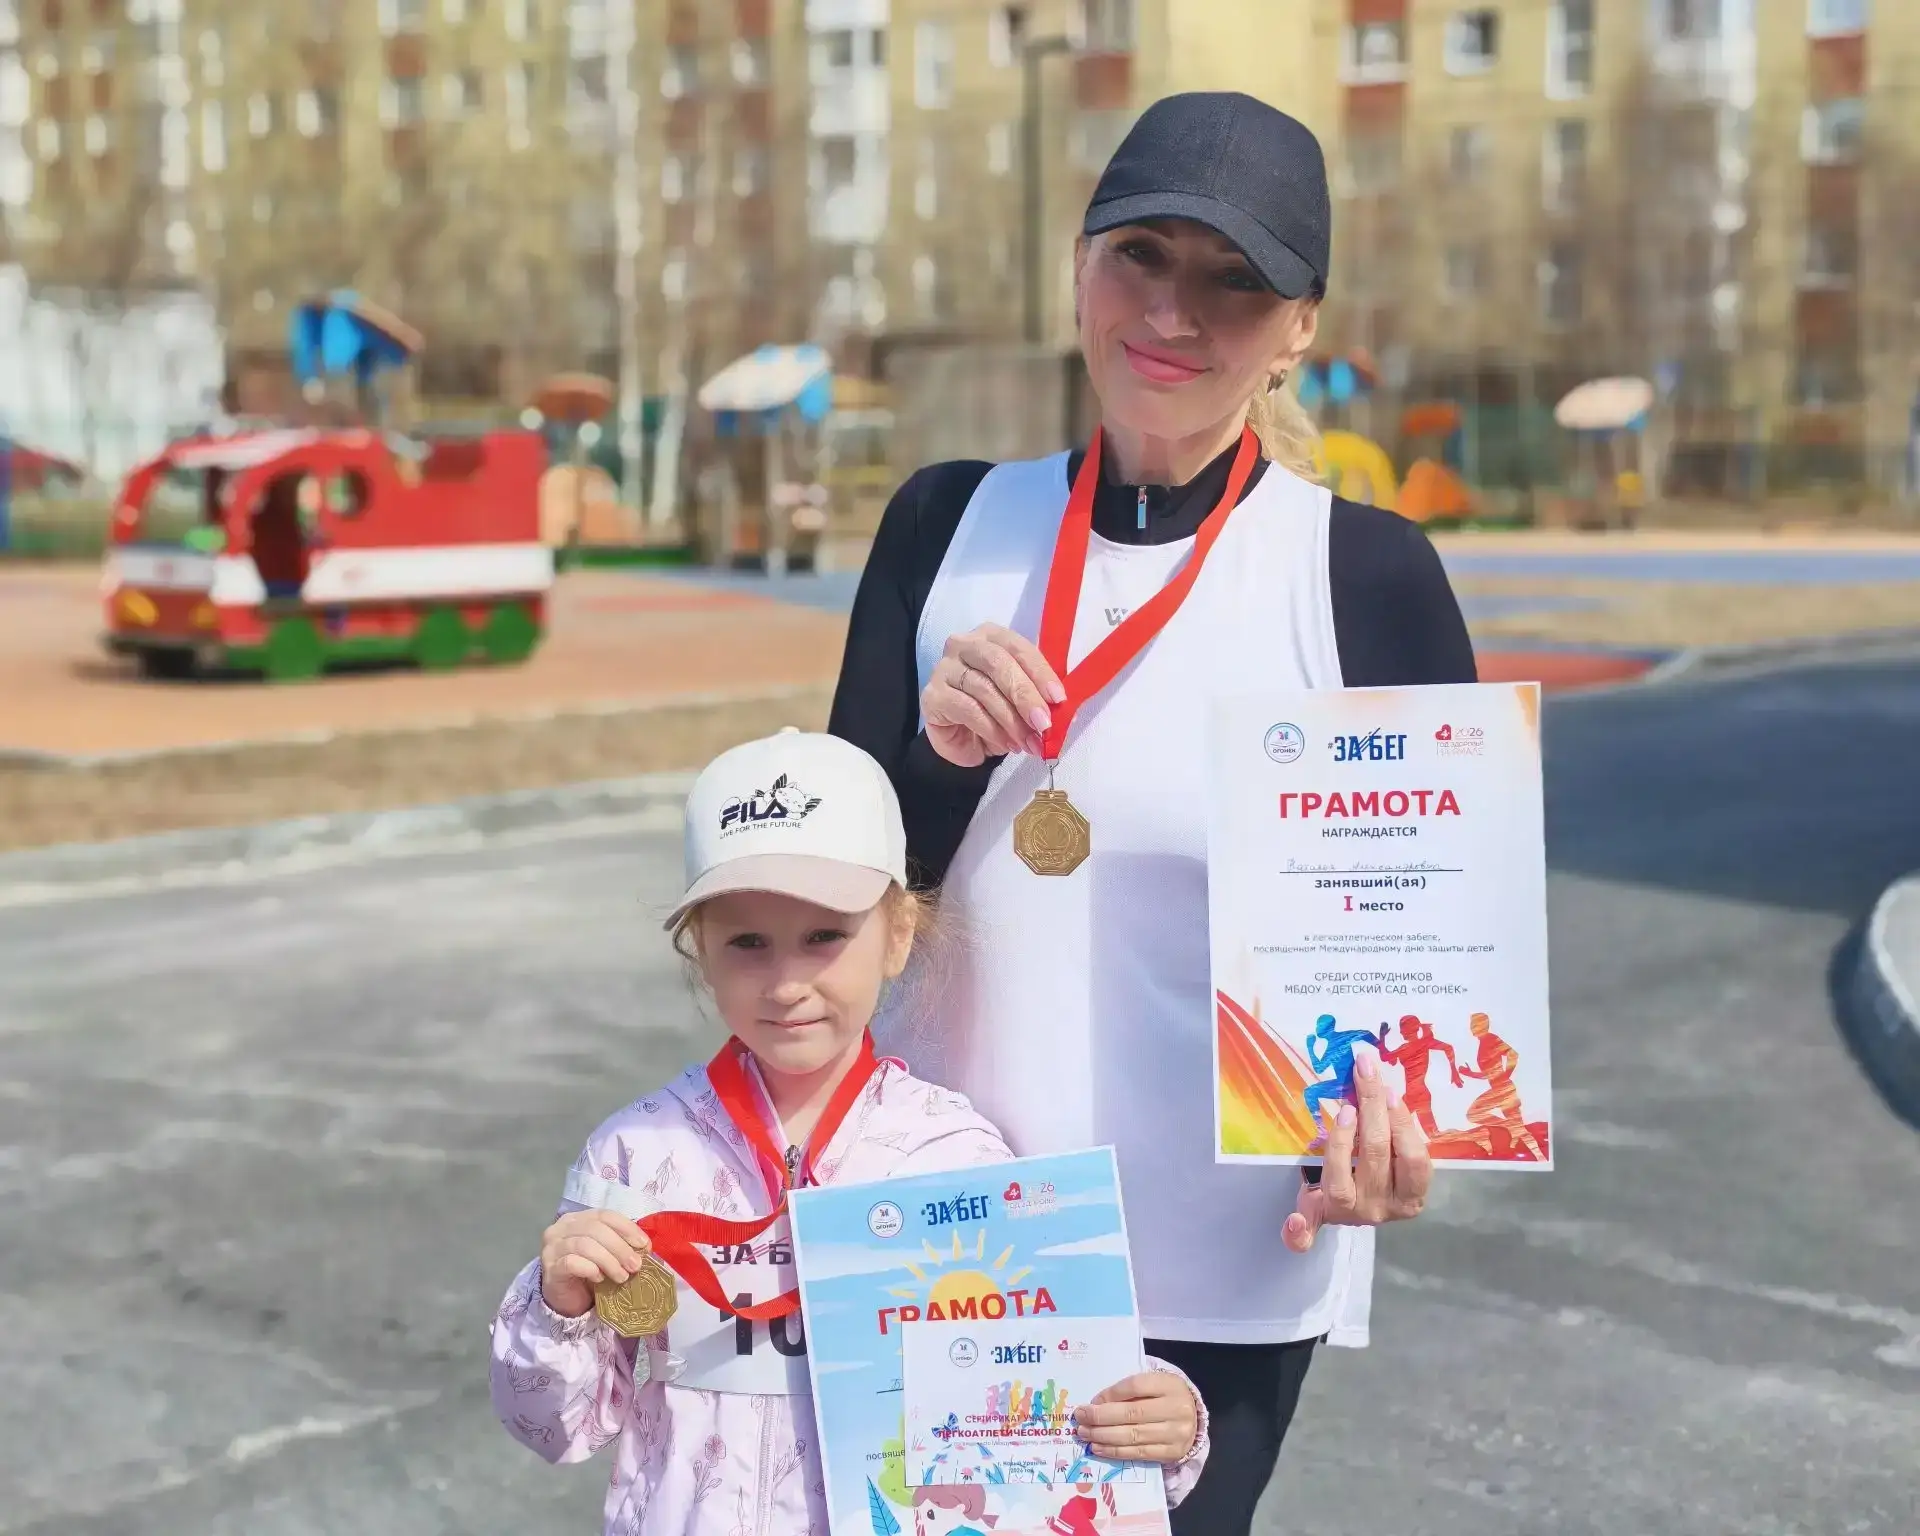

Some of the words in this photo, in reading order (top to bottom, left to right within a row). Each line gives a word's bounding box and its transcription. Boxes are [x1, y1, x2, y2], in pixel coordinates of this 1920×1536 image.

[1279, 789, 1461, 819] ГРАМОТА
[720, 799, 789, 830] FILA
[719, 830, 734, 840] LIVE
[735, 825, 751, 834] FOR
[770, 821, 802, 829] FUTURE
[1322, 826, 1417, 839] НАГРАЖДАЕТСЯ
[1314, 876, 1427, 890] занявший(ая)
[1359, 902, 1404, 911] место
[1319, 945, 1401, 954] Международному
[1467, 944, 1495, 953] детей
[1314, 972, 1349, 982] СРЕДИ
[1352, 972, 1433, 983] СОТРУДНИКОВ
[1284, 984, 1322, 995] МБДОУ
[1325, 983, 1381, 996] «ДЕТСКИЙ
[1385, 984, 1408, 996] САД
[877, 1287, 1058, 1336] ГРАМОТА
[964, 1414, 1021, 1424] СЕРТИФИКАТ
[1024, 1413, 1077, 1423] УЧАСТНИКА
[939, 1427, 1062, 1438] ЛЕГКОАТЛЕТИЧЕСКОГО
[1065, 1427, 1078, 1437] ЗА
[866, 1449, 905, 1461] посвяще
